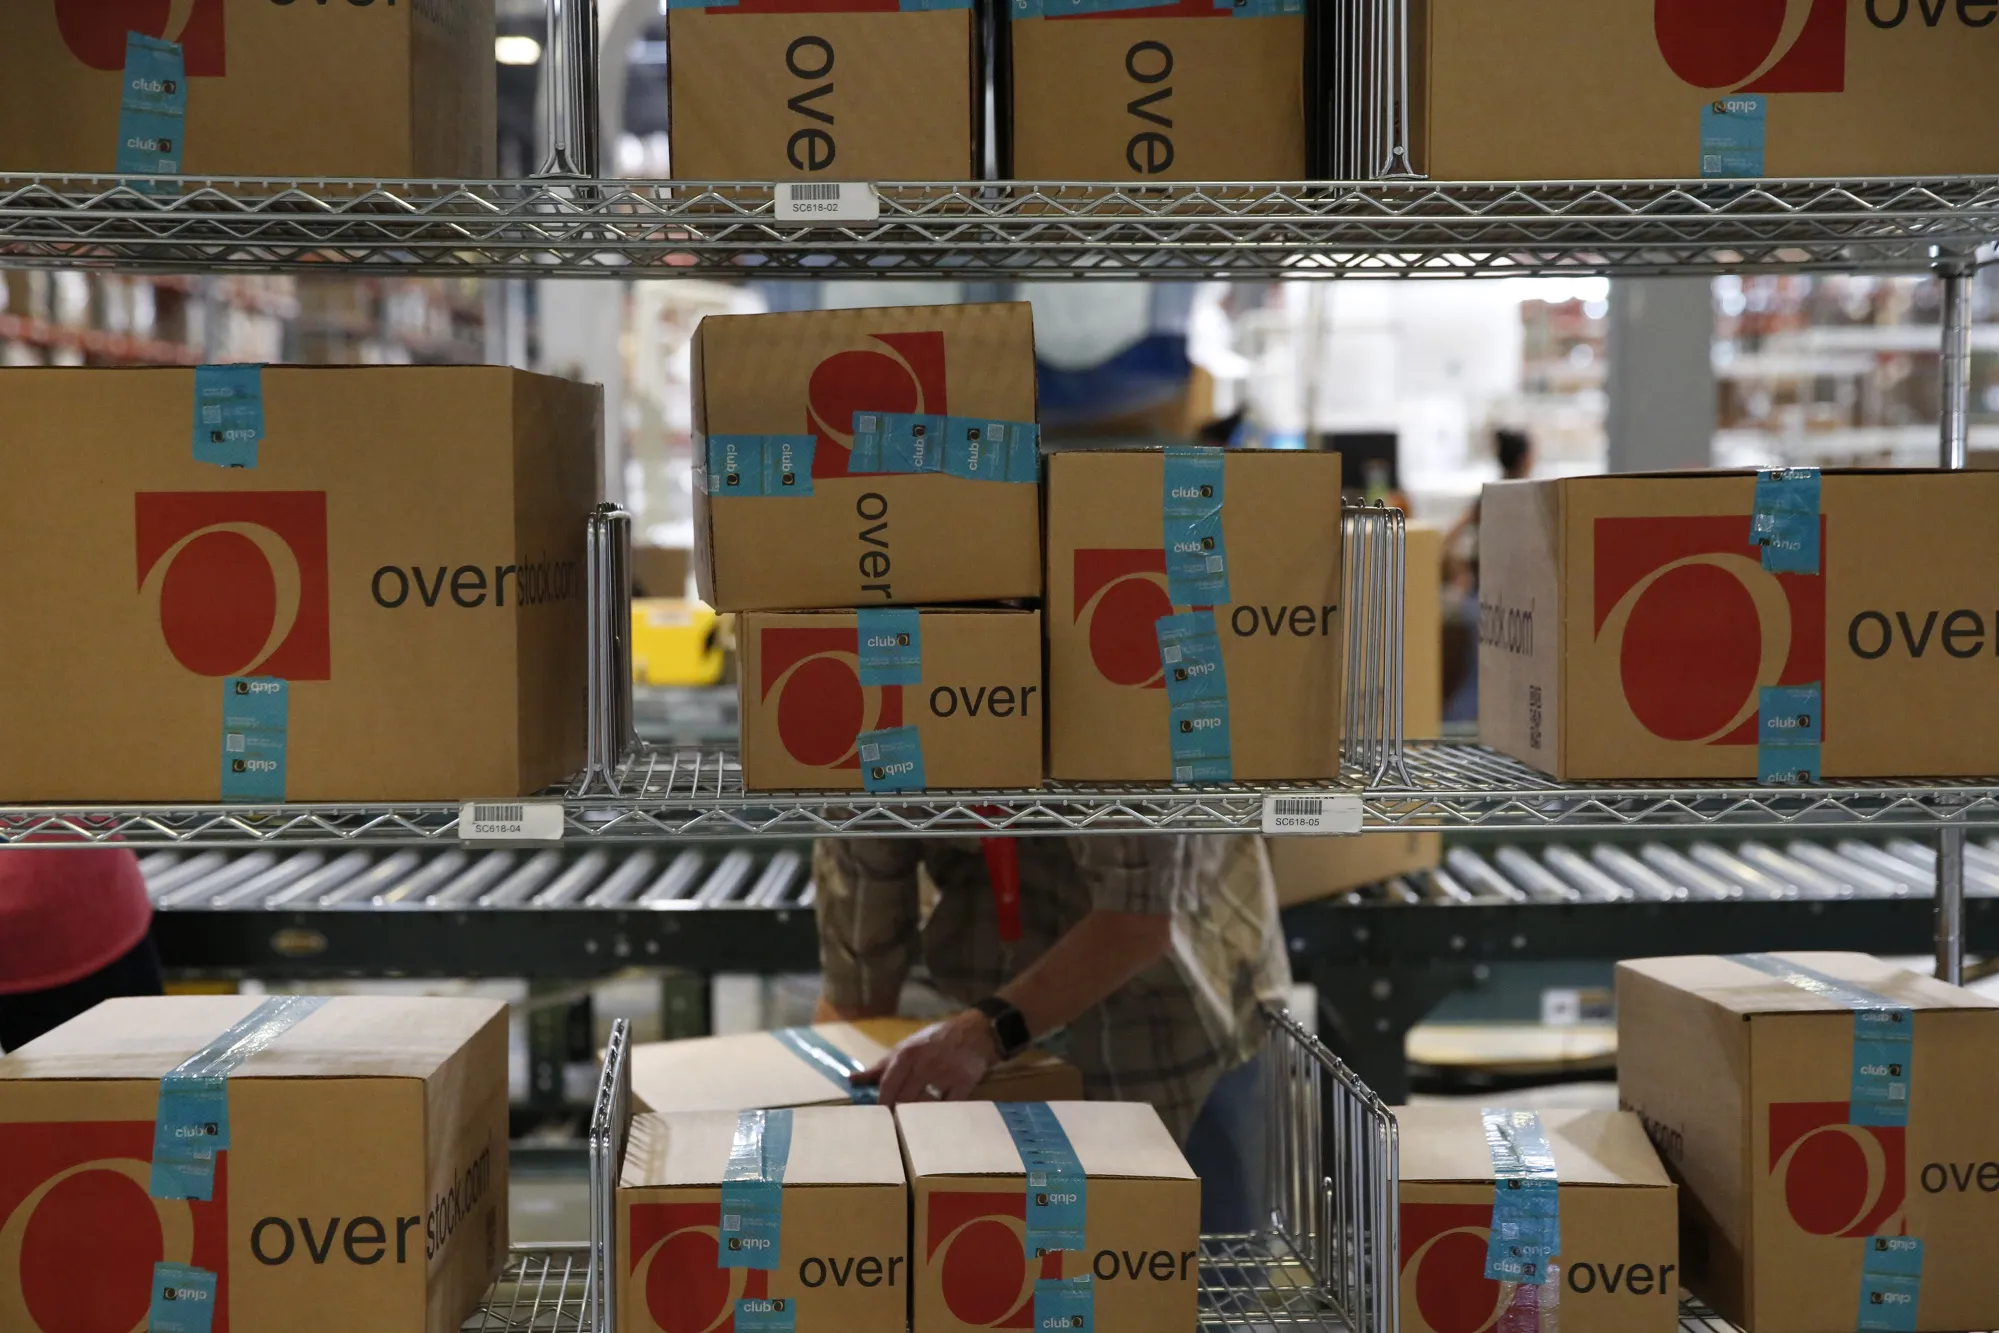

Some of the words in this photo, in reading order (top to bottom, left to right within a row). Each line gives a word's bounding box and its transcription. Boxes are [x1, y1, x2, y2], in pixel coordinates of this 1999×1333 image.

[792, 203, 839, 212] SC618-02
[857, 492, 893, 600] over
[371, 564, 515, 609] over
[1231, 604, 1337, 637] over
[929, 685, 1037, 718] over
[475, 824, 521, 833] SC618-04
[1275, 818, 1320, 826] SC618-05
[426, 1147, 490, 1261] stock.com
[250, 1215, 421, 1266] over
[799, 1256, 904, 1288] over
[1092, 1249, 1196, 1282] over
[1567, 1262, 1675, 1296] over
